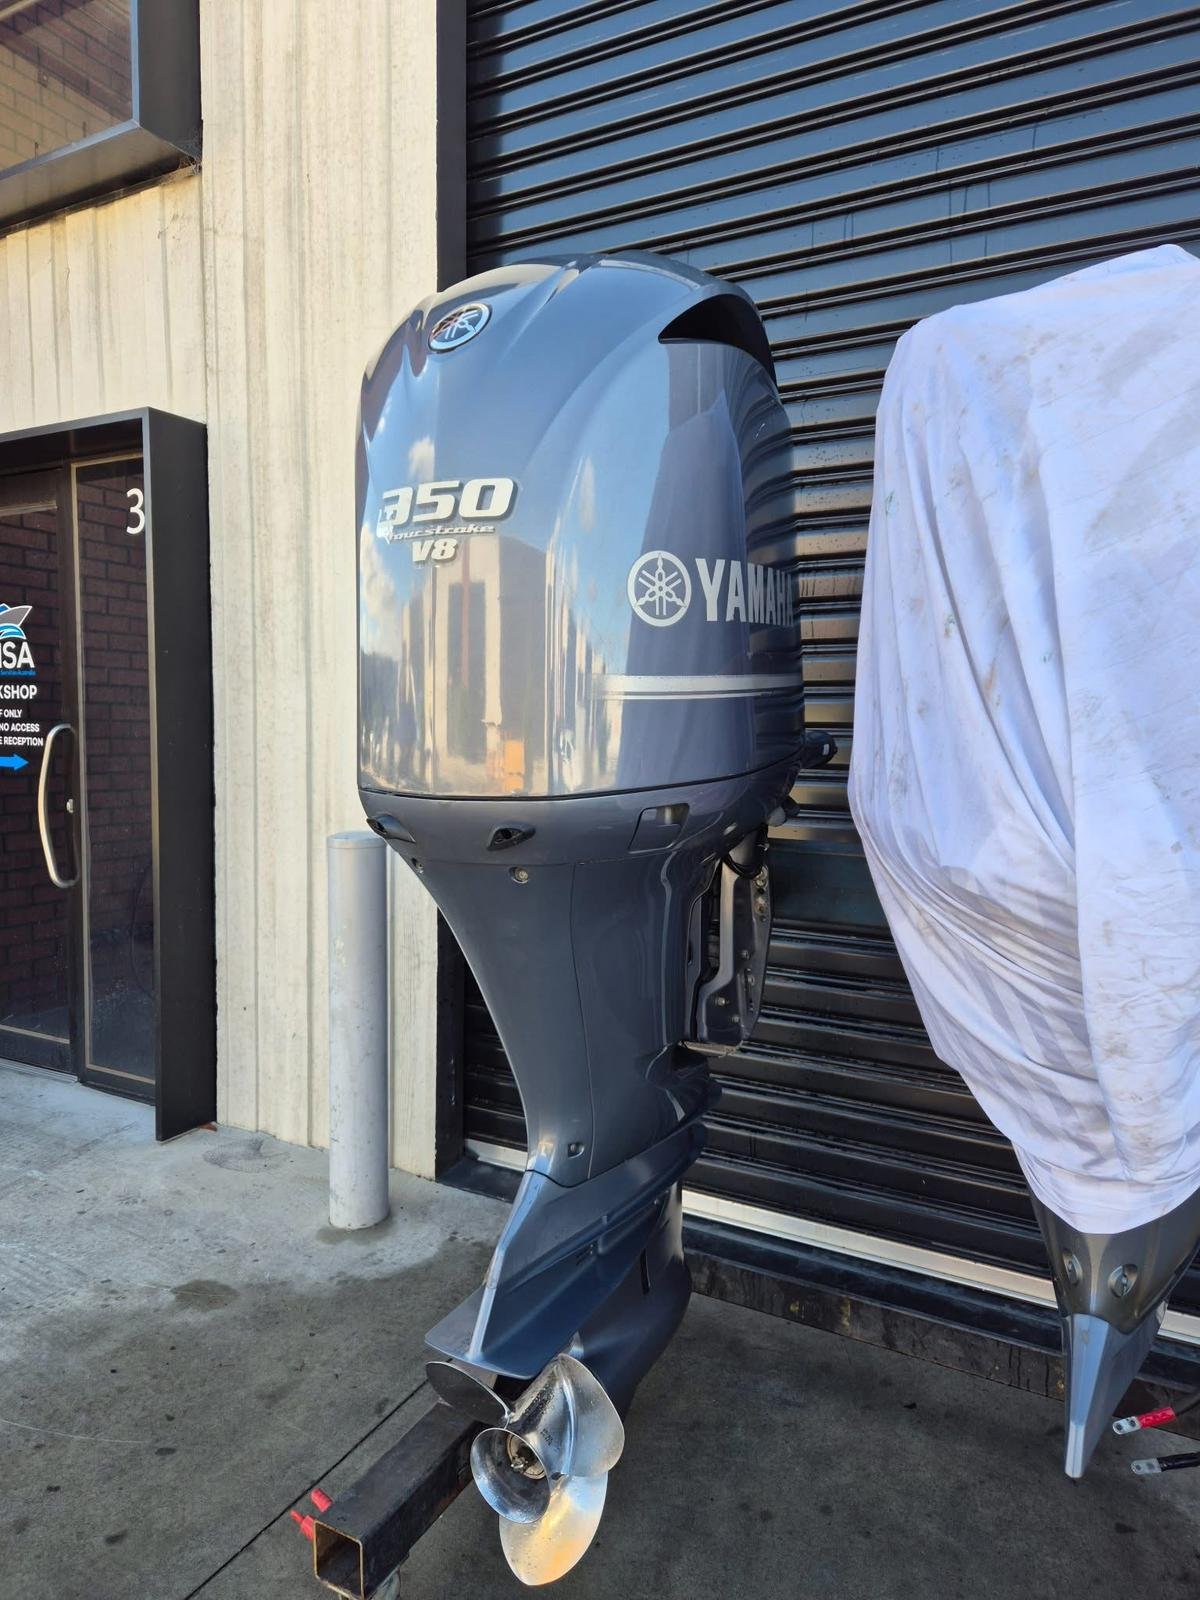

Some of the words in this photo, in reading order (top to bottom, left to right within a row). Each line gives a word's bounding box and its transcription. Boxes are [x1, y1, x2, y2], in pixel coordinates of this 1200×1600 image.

[126, 487, 145, 535] 3
[411, 537, 458, 562] V8
[695, 557, 794, 627] YAMAHA
[3, 709, 23, 718] ONLY
[10, 723, 40, 733] ACCESS
[3, 736, 44, 747] RECEPTION
